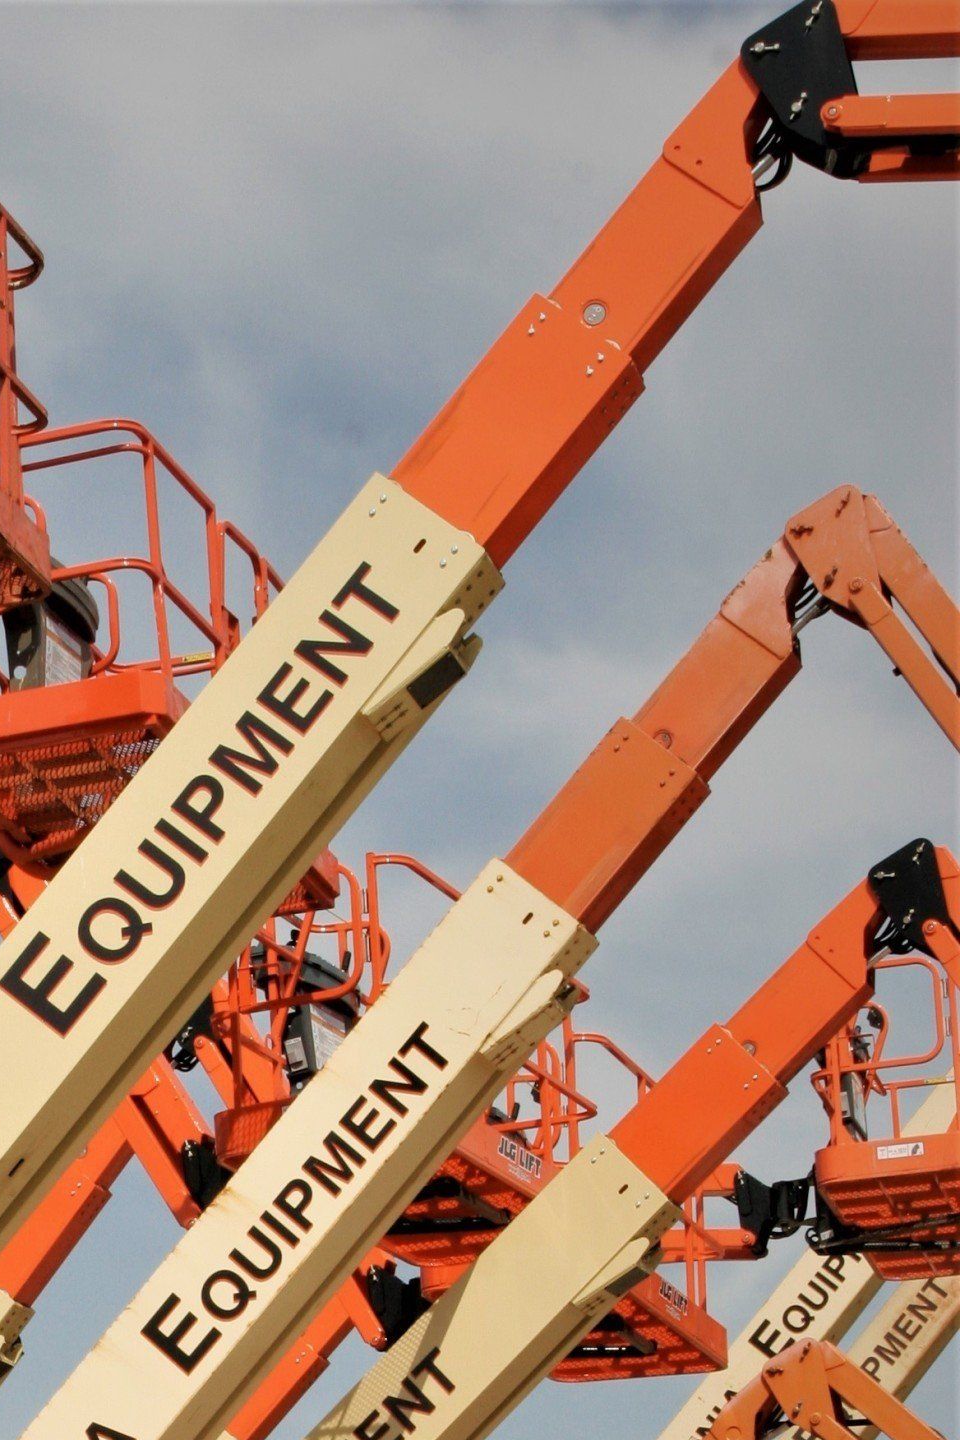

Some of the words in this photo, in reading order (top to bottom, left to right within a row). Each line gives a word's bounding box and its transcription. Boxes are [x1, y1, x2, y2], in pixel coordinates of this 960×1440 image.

[0, 562, 403, 1038] EQUIPMENT
[141, 1021, 452, 1378] EQUIPMENT
[498, 1136, 517, 1164] JLG
[520, 1147, 542, 1177] LIFT
